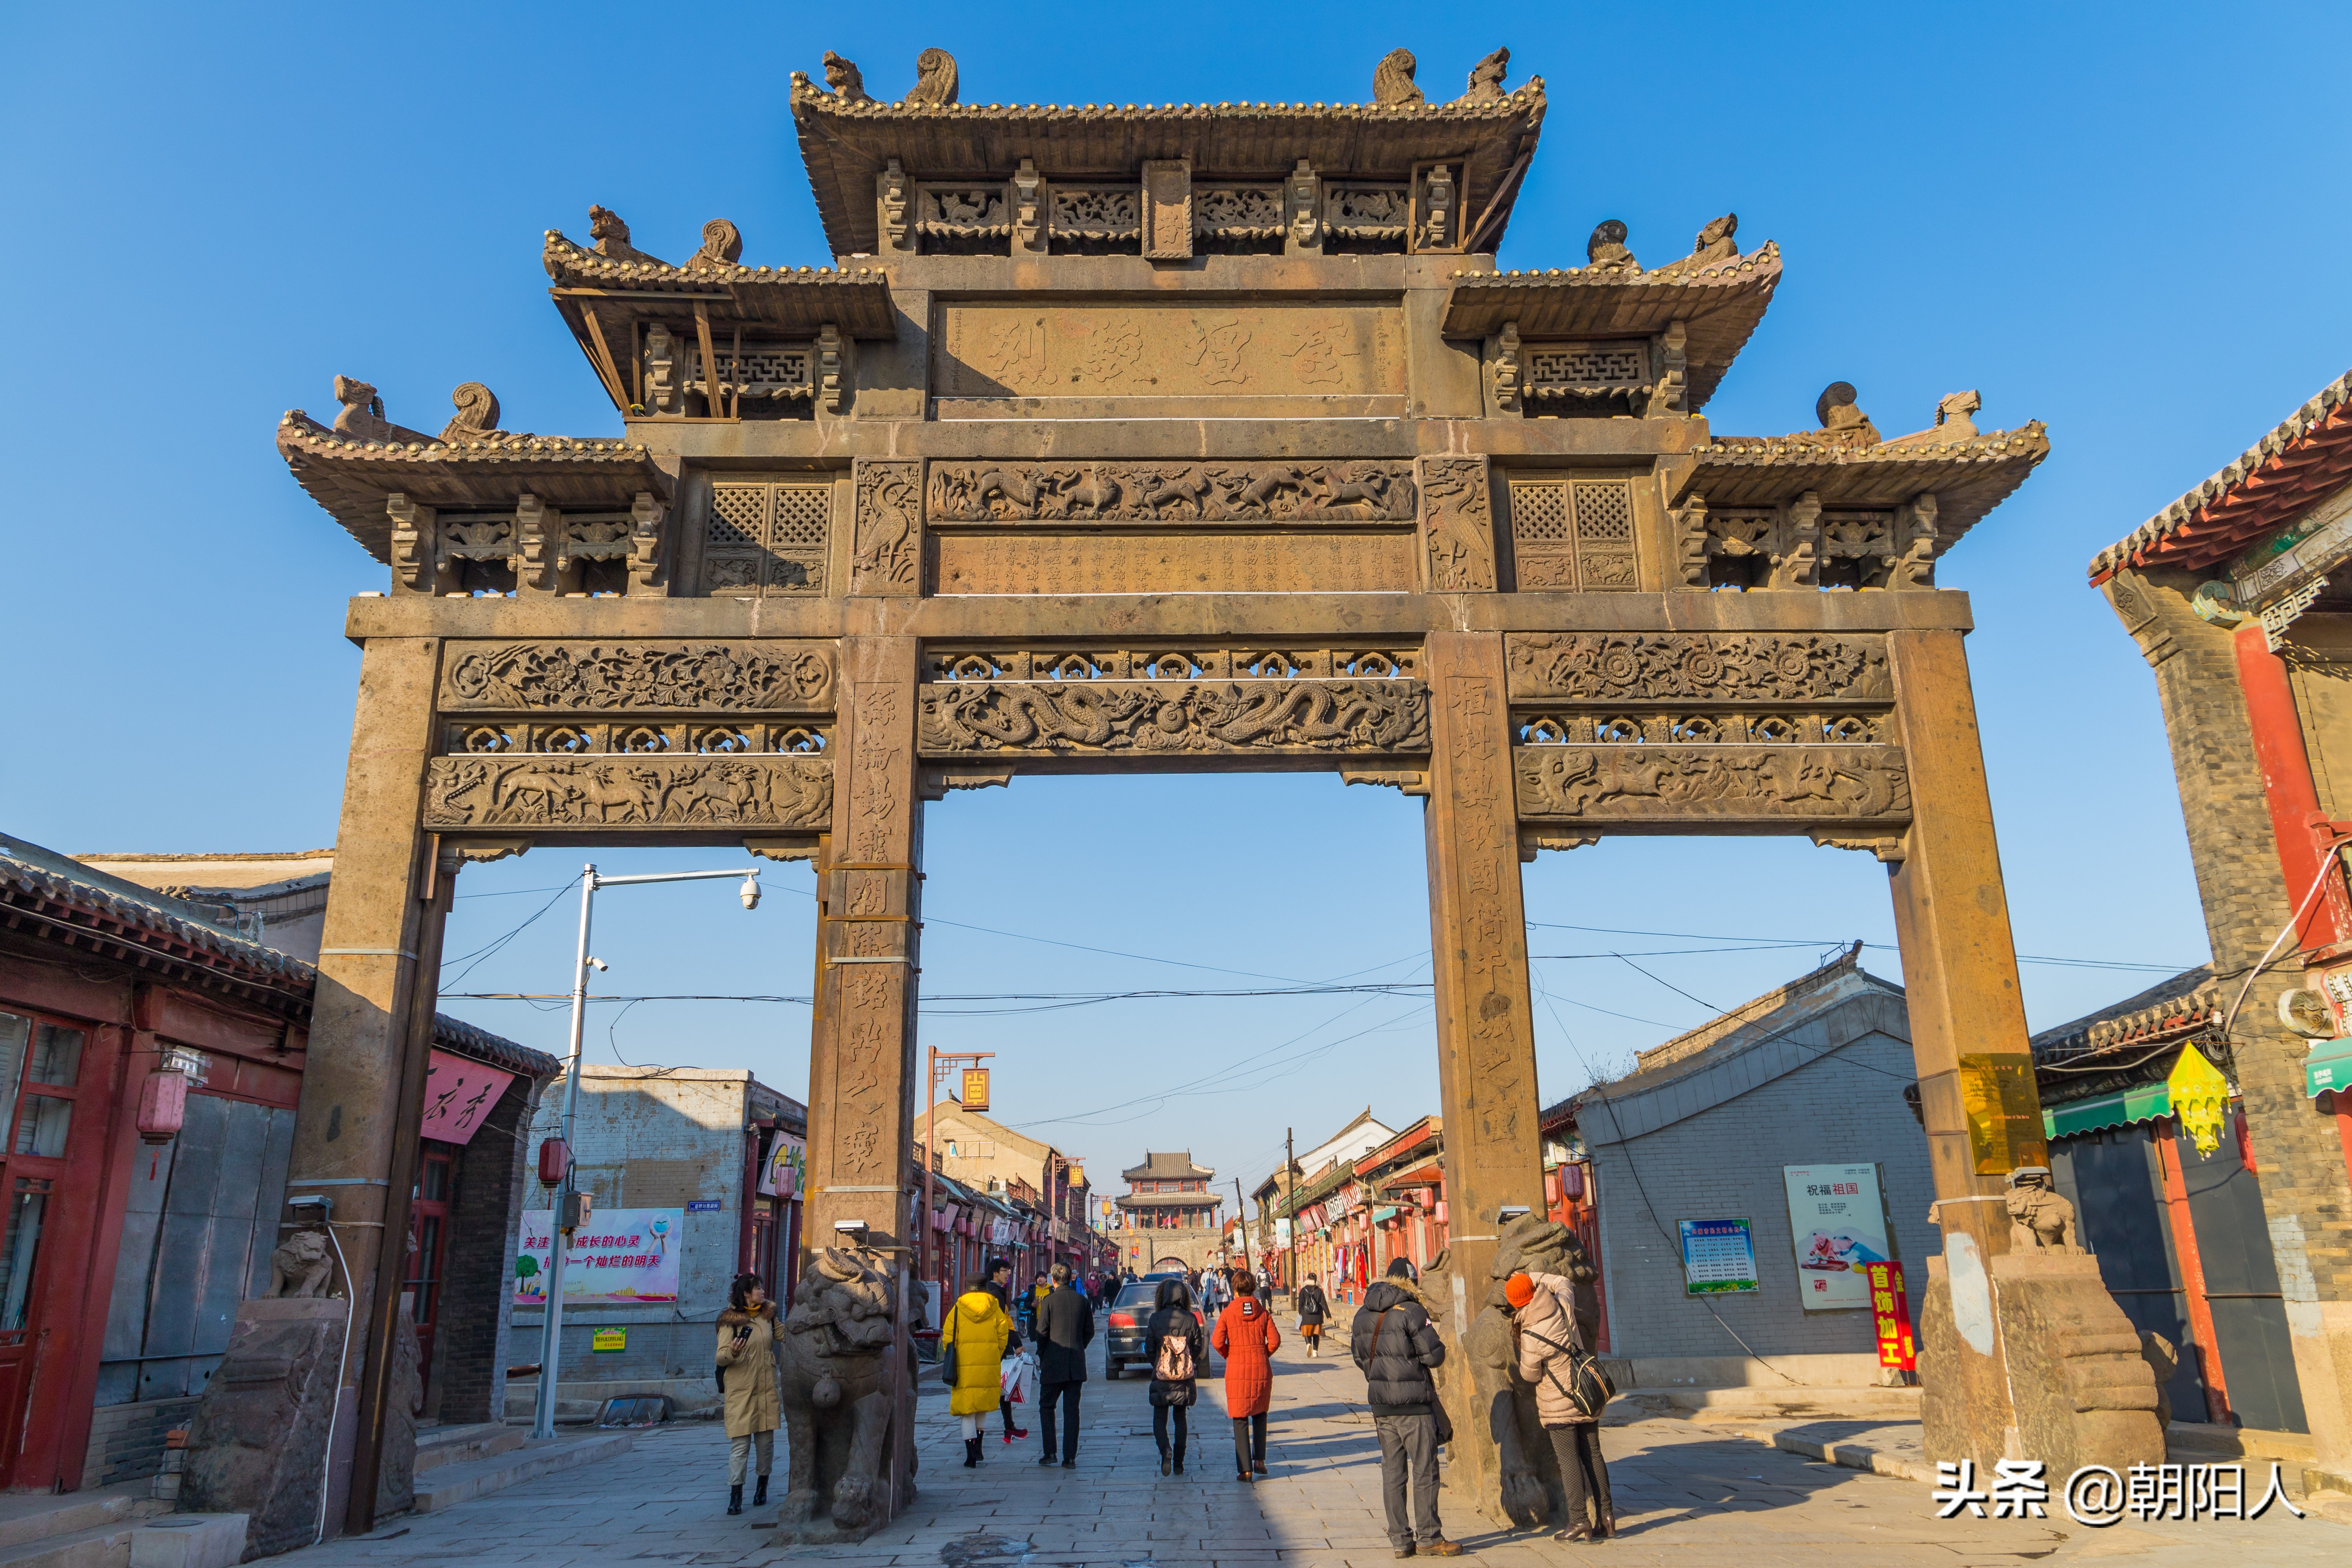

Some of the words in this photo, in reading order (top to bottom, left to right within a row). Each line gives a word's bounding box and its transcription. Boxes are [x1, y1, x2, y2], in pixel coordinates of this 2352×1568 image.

[1807, 1183, 1858, 1196] 祝福祖国
[523, 1235, 640, 1249] 关注成长的心灵
[543, 1254, 660, 1268] 一个灿烂的明天
[1870, 1266, 1902, 1363] 首饰加工
